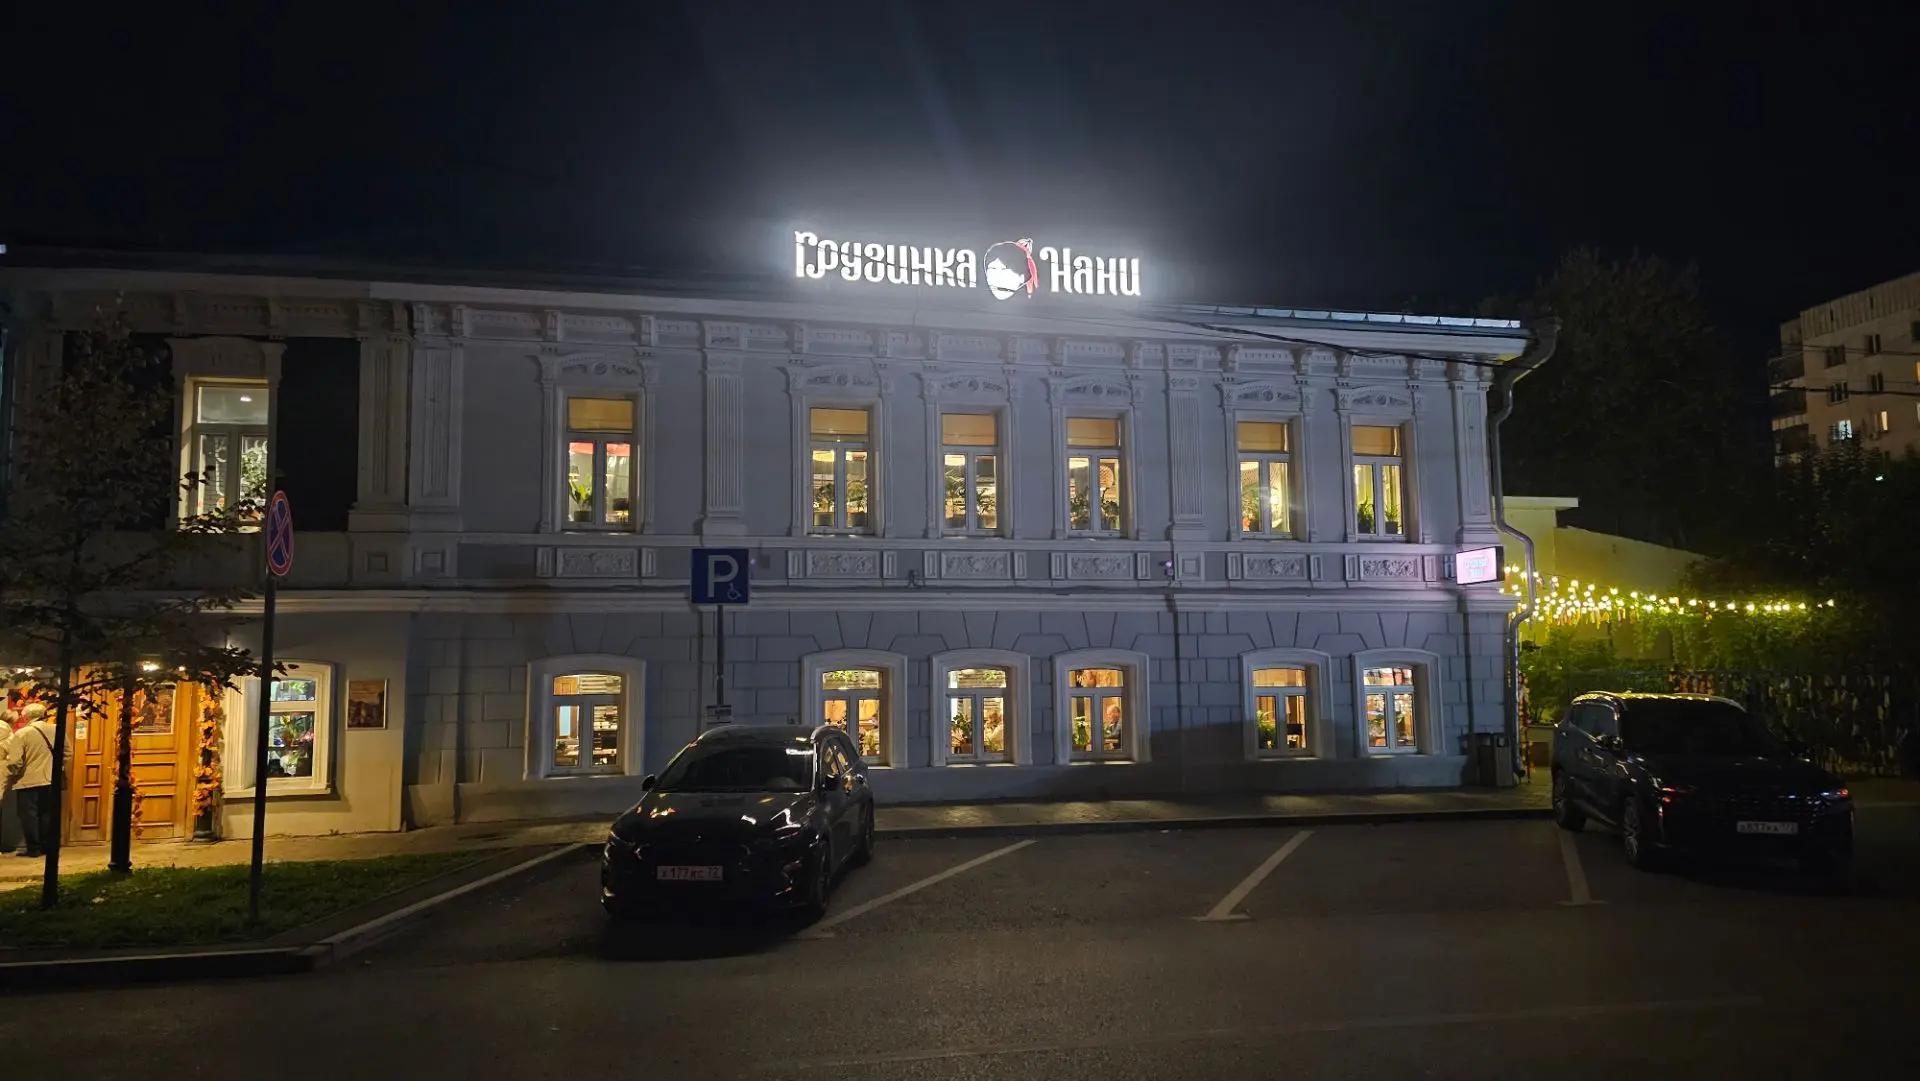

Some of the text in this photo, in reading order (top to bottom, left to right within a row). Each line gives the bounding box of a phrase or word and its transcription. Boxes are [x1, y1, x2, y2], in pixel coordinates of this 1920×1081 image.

[794, 230, 1141, 297] Грузинка Нани
[707, 554, 739, 598] P
